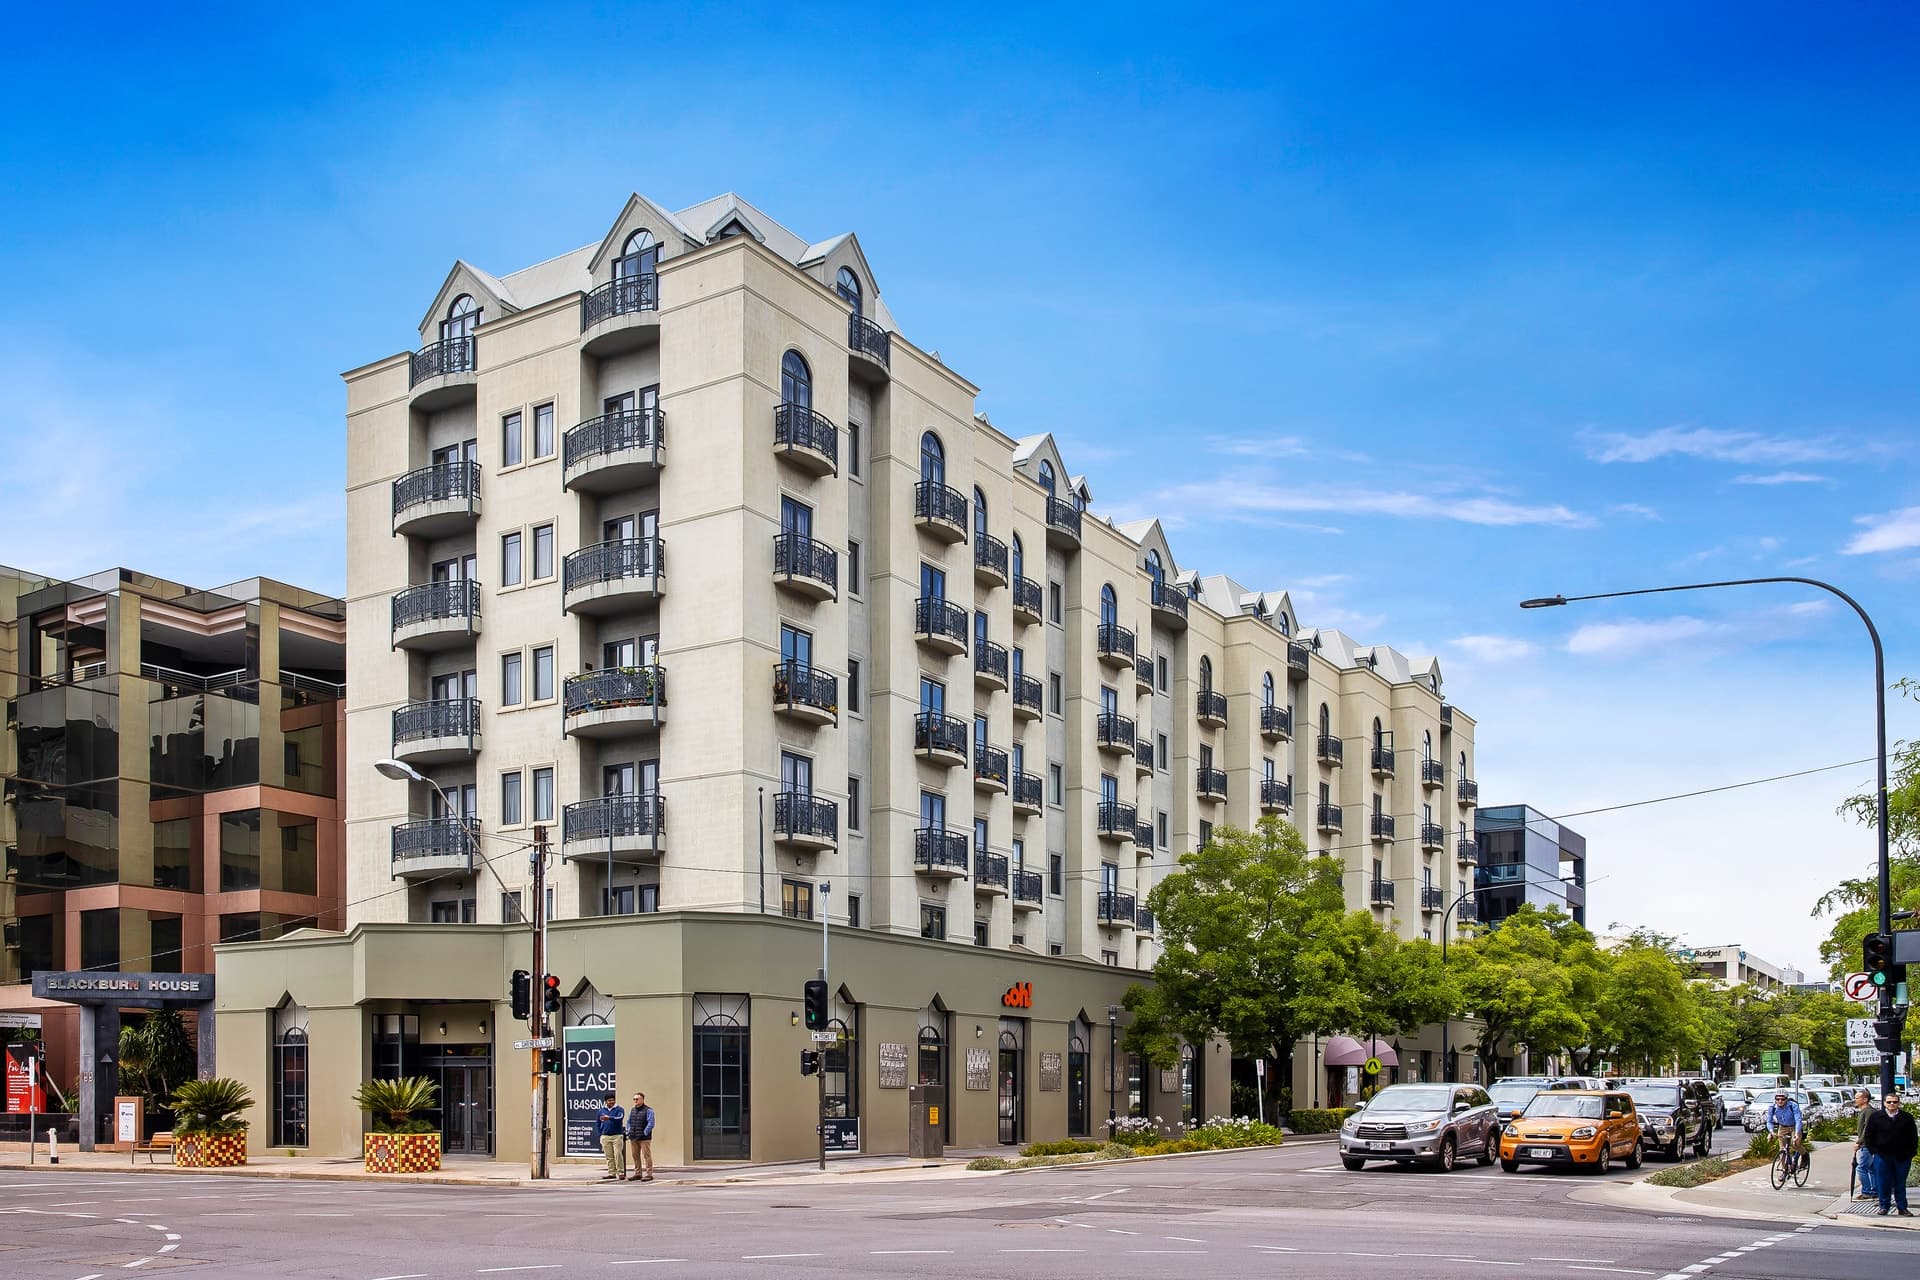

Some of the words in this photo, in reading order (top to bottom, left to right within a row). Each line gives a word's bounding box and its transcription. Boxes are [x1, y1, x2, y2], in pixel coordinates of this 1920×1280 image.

[47, 978, 140, 991] BLACKBURN
[149, 980, 200, 991] HOUSE
[567, 1049, 602, 1068] FOR
[568, 1072, 617, 1092] LEASE
[842, 1131, 857, 1141] belle
